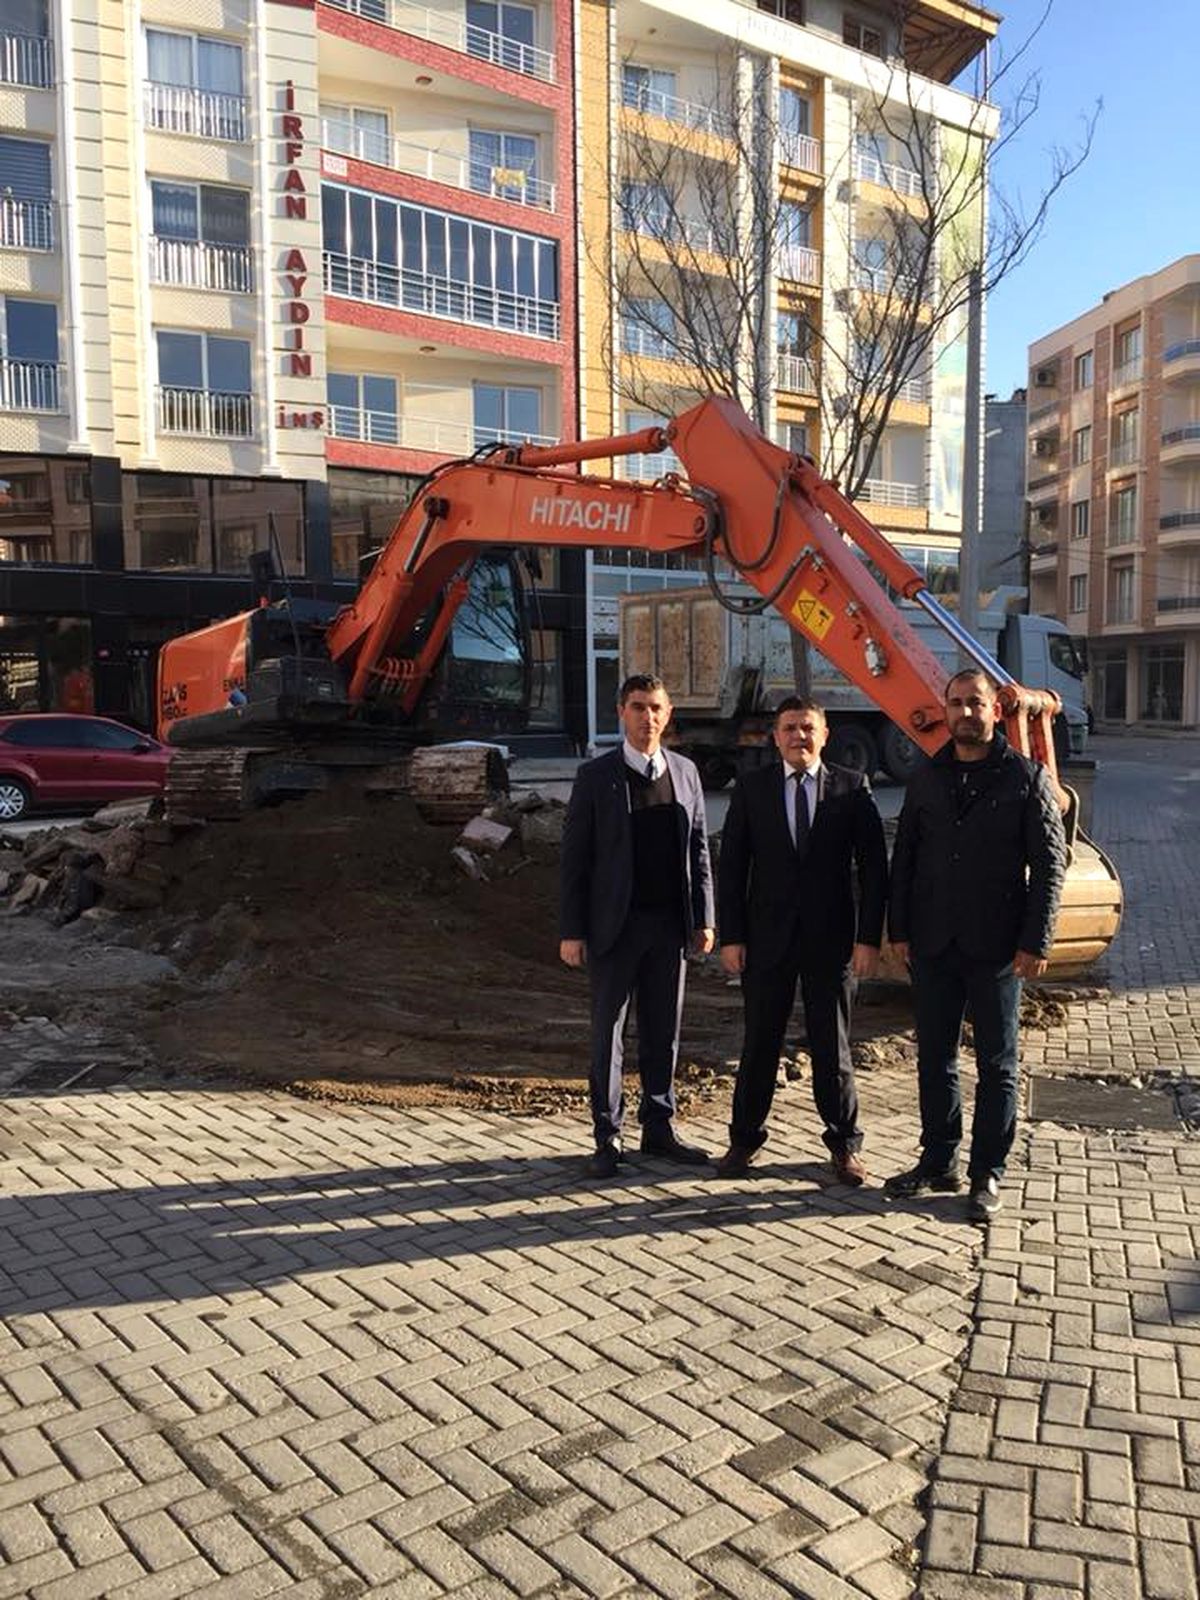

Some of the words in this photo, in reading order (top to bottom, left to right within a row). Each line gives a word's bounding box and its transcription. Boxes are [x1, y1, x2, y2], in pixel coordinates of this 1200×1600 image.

[282, 80, 306, 220] İRFAN
[285, 249, 311, 376] AYDIN
[530, 496, 631, 533] HITACHI
